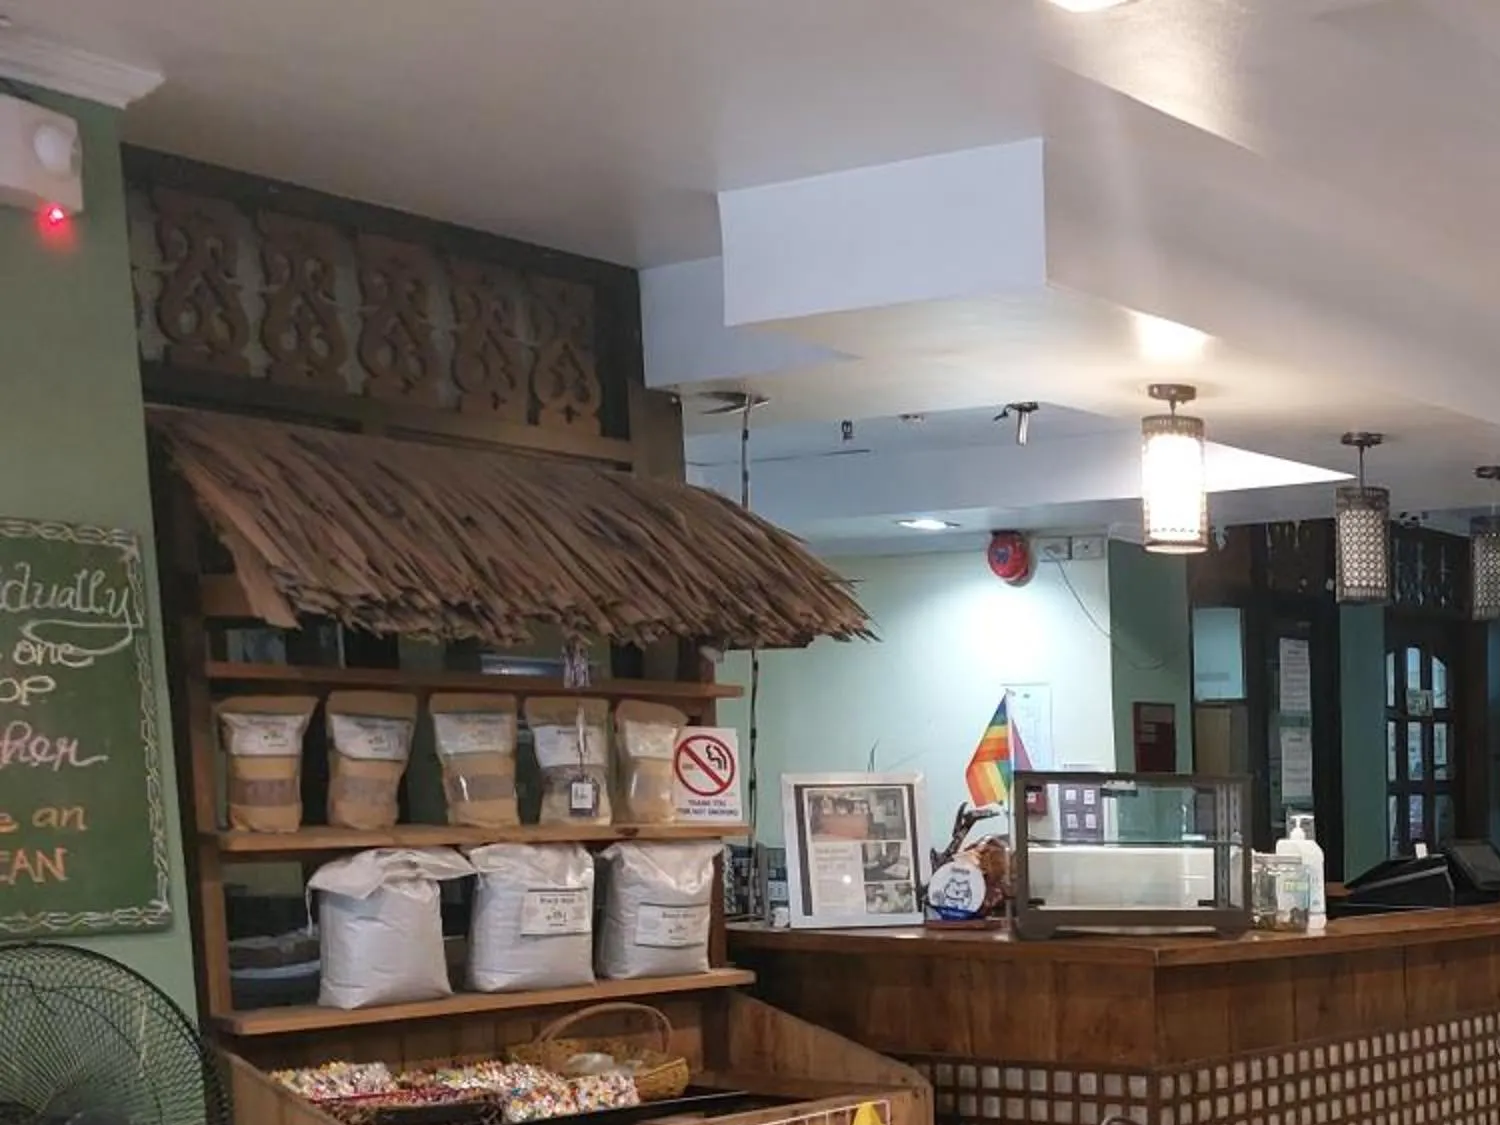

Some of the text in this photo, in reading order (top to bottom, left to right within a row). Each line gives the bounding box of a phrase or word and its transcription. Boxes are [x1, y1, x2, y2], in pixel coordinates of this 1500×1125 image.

[0, 561, 134, 652] dually
[0, 675, 56, 705] OP
[0, 720, 109, 772] her
[32, 806, 88, 831] an
[0, 847, 69, 885] EAN
